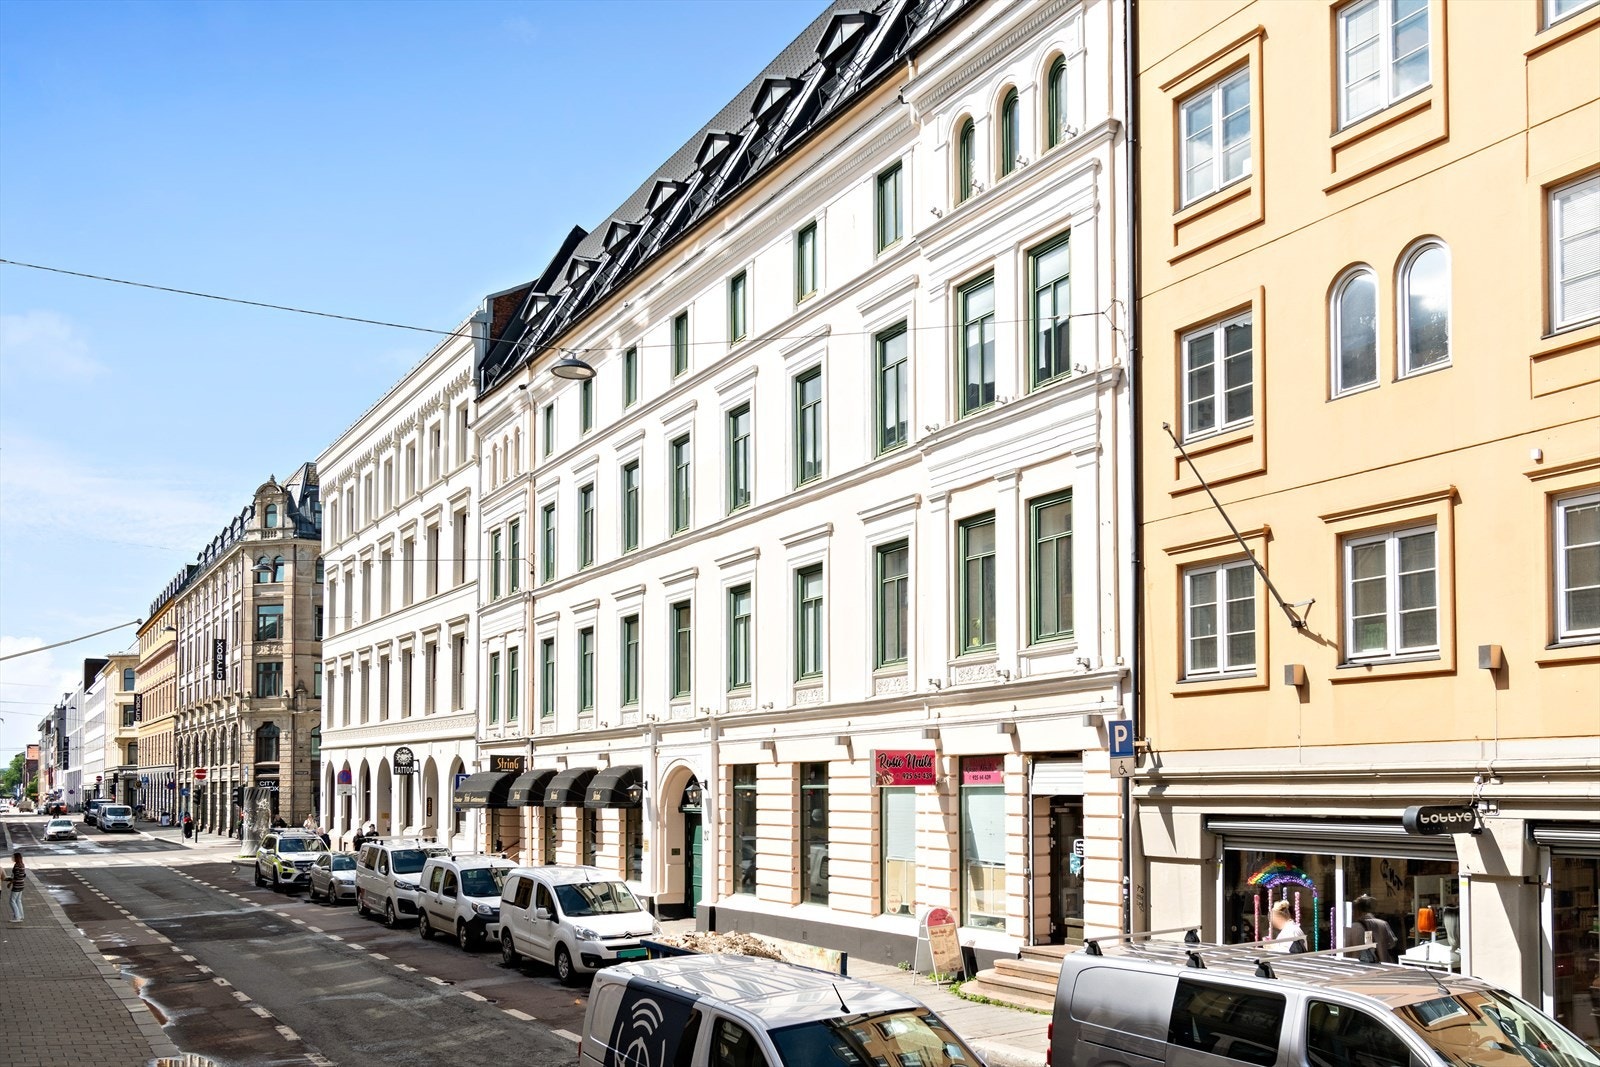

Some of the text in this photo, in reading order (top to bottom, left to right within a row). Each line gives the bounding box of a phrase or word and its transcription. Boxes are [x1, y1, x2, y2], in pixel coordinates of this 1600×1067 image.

[1114, 725, 1128, 753] P
[395, 766, 414, 774] TATTOO
[905, 753, 932, 770] Nails
